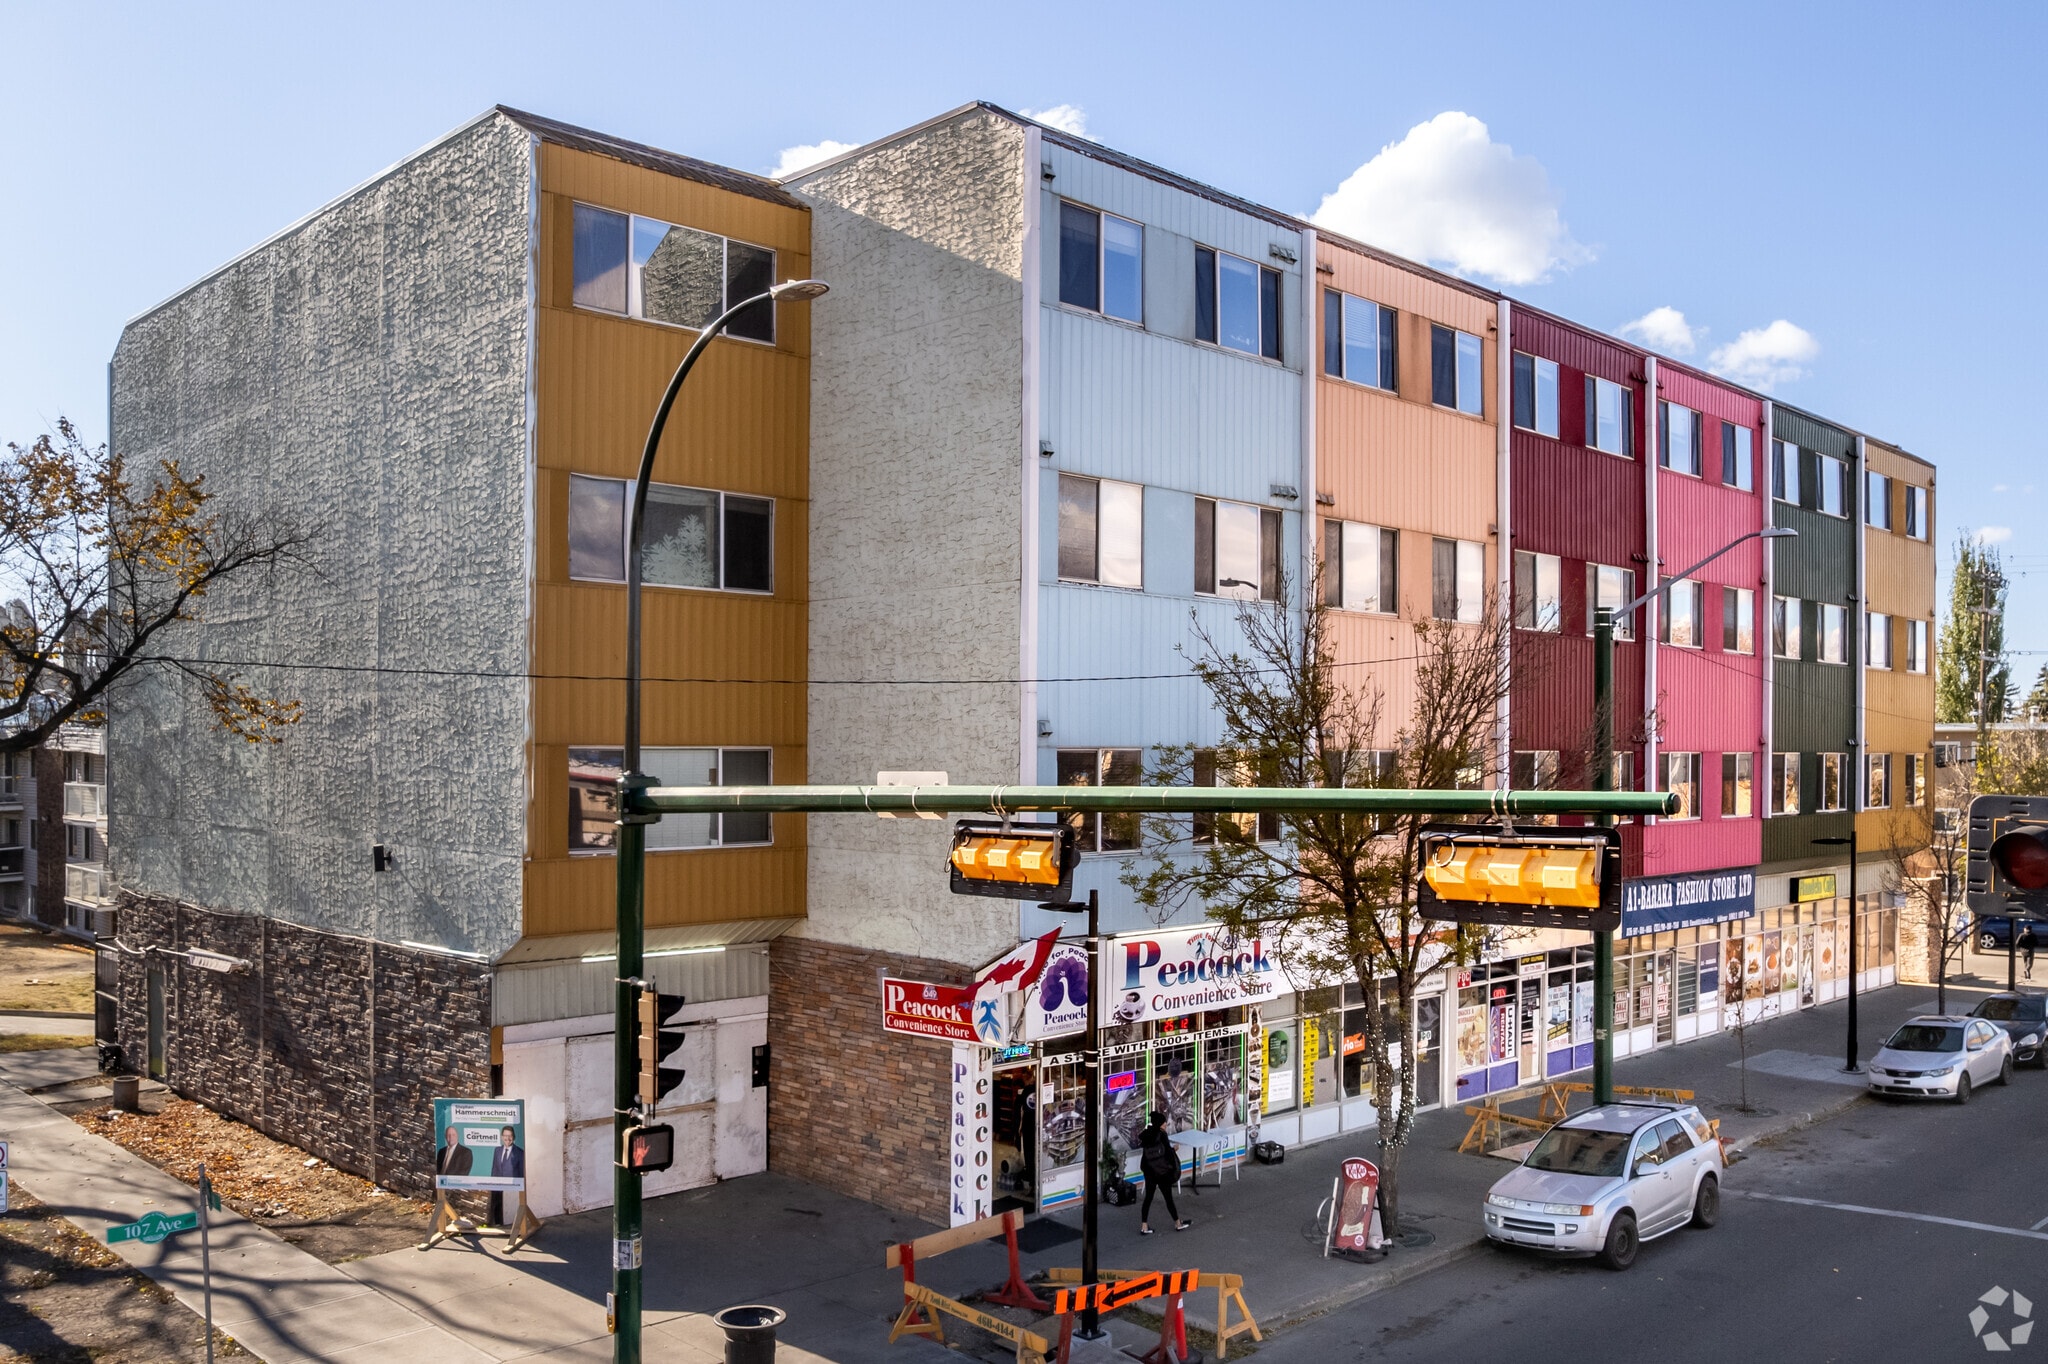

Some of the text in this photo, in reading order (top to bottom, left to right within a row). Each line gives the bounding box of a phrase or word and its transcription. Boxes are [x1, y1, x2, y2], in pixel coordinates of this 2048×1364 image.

[1675, 879, 1711, 906] FASHION
[1711, 876, 1736, 901] STORE
[1738, 874, 1752, 898] LTD
[1051, 949, 1065, 961] for
[1120, 939, 1273, 991] Peacock
[886, 984, 963, 1022] Peacock
[1152, 986, 1237, 1012] Convenience
[886, 1015, 970, 1039] Convenience Store
[1043, 1021, 1074, 1033] Convenience
[1044, 1007, 1087, 1026] Peacock
[1163, 1018, 1189, 1032] 25 12
[1049, 1056, 1060, 1066] A
[1114, 1041, 1148, 1055] WITH
[1152, 1035, 1190, 1048] 5000+
[455, 1109, 517, 1117] Hammerschmidt
[953, 1062, 968, 1217] Peacock
[974, 1047, 992, 1222] Peacock
[124, 1223, 151, 1239] 107
[155, 1219, 182, 1233] Ave
